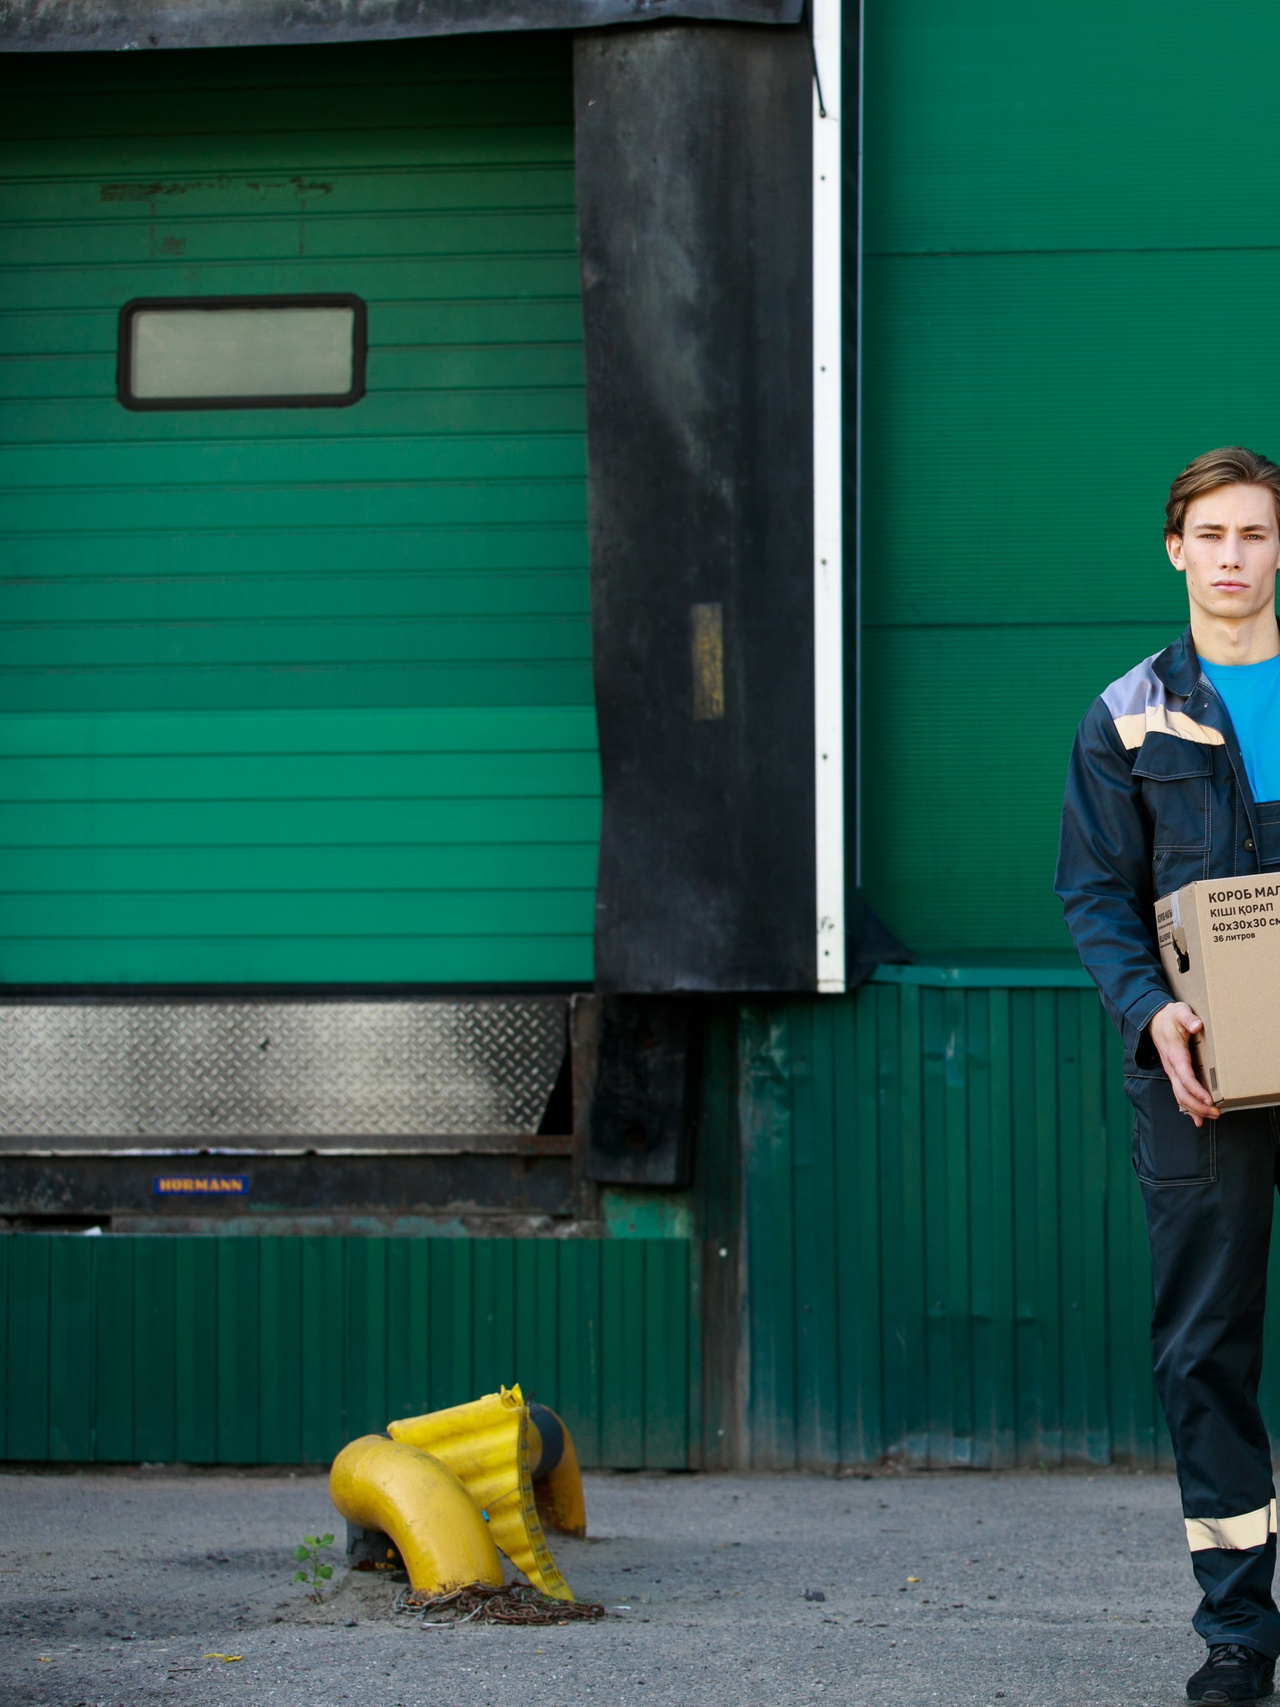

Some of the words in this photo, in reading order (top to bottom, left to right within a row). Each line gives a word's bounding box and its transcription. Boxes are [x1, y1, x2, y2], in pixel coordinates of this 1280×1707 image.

[1208, 889, 1252, 903] КОРОБ
[1210, 907, 1236, 918] КІШІ
[1238, 903, 1274, 916] ҚОРАП
[1213, 935, 1224, 943] 36
[1225, 932, 1256, 941] литров
